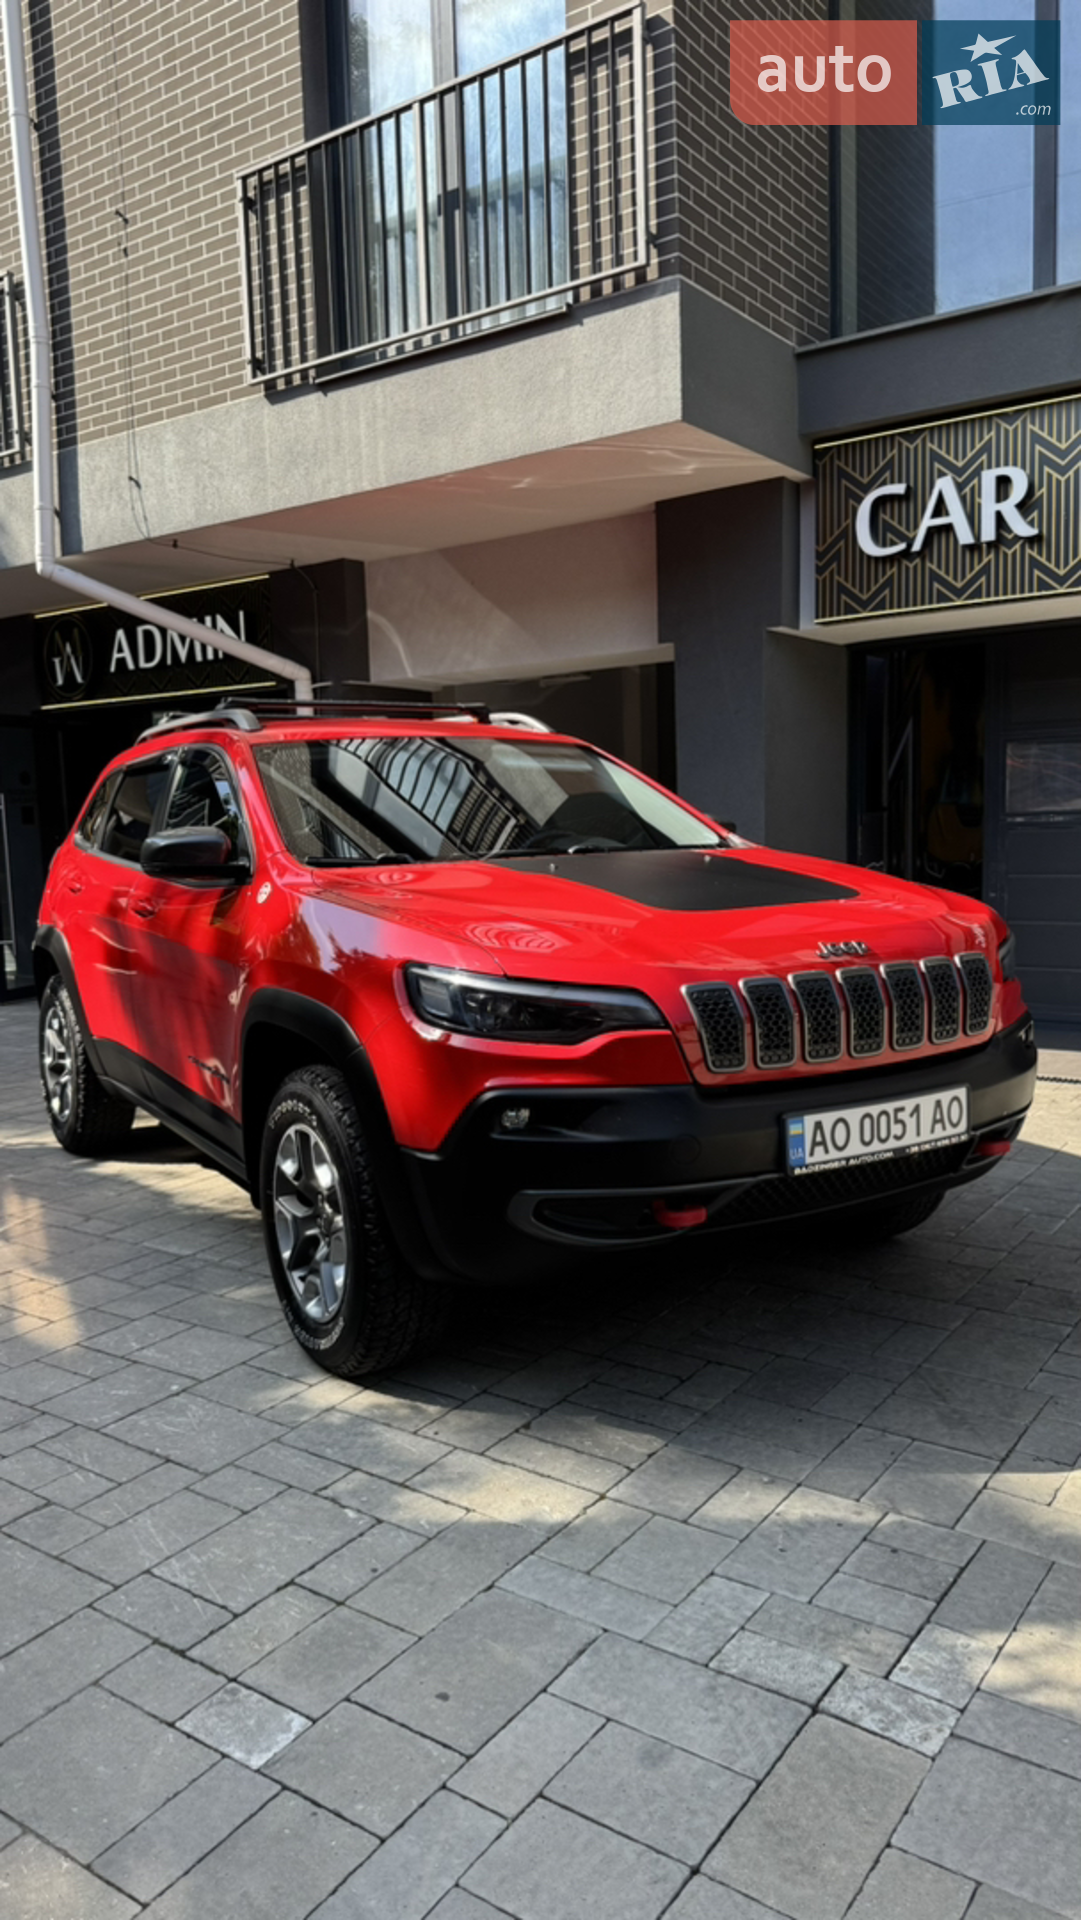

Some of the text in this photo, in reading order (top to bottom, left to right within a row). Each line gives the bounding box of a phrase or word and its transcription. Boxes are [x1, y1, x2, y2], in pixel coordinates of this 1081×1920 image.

[855, 466, 1039, 557] CAR
[790, 1147, 804, 1159] UA
[808, 1117, 850, 1157] AO
[859, 1103, 921, 1147] 0051
[930, 1095, 963, 1134] AO
